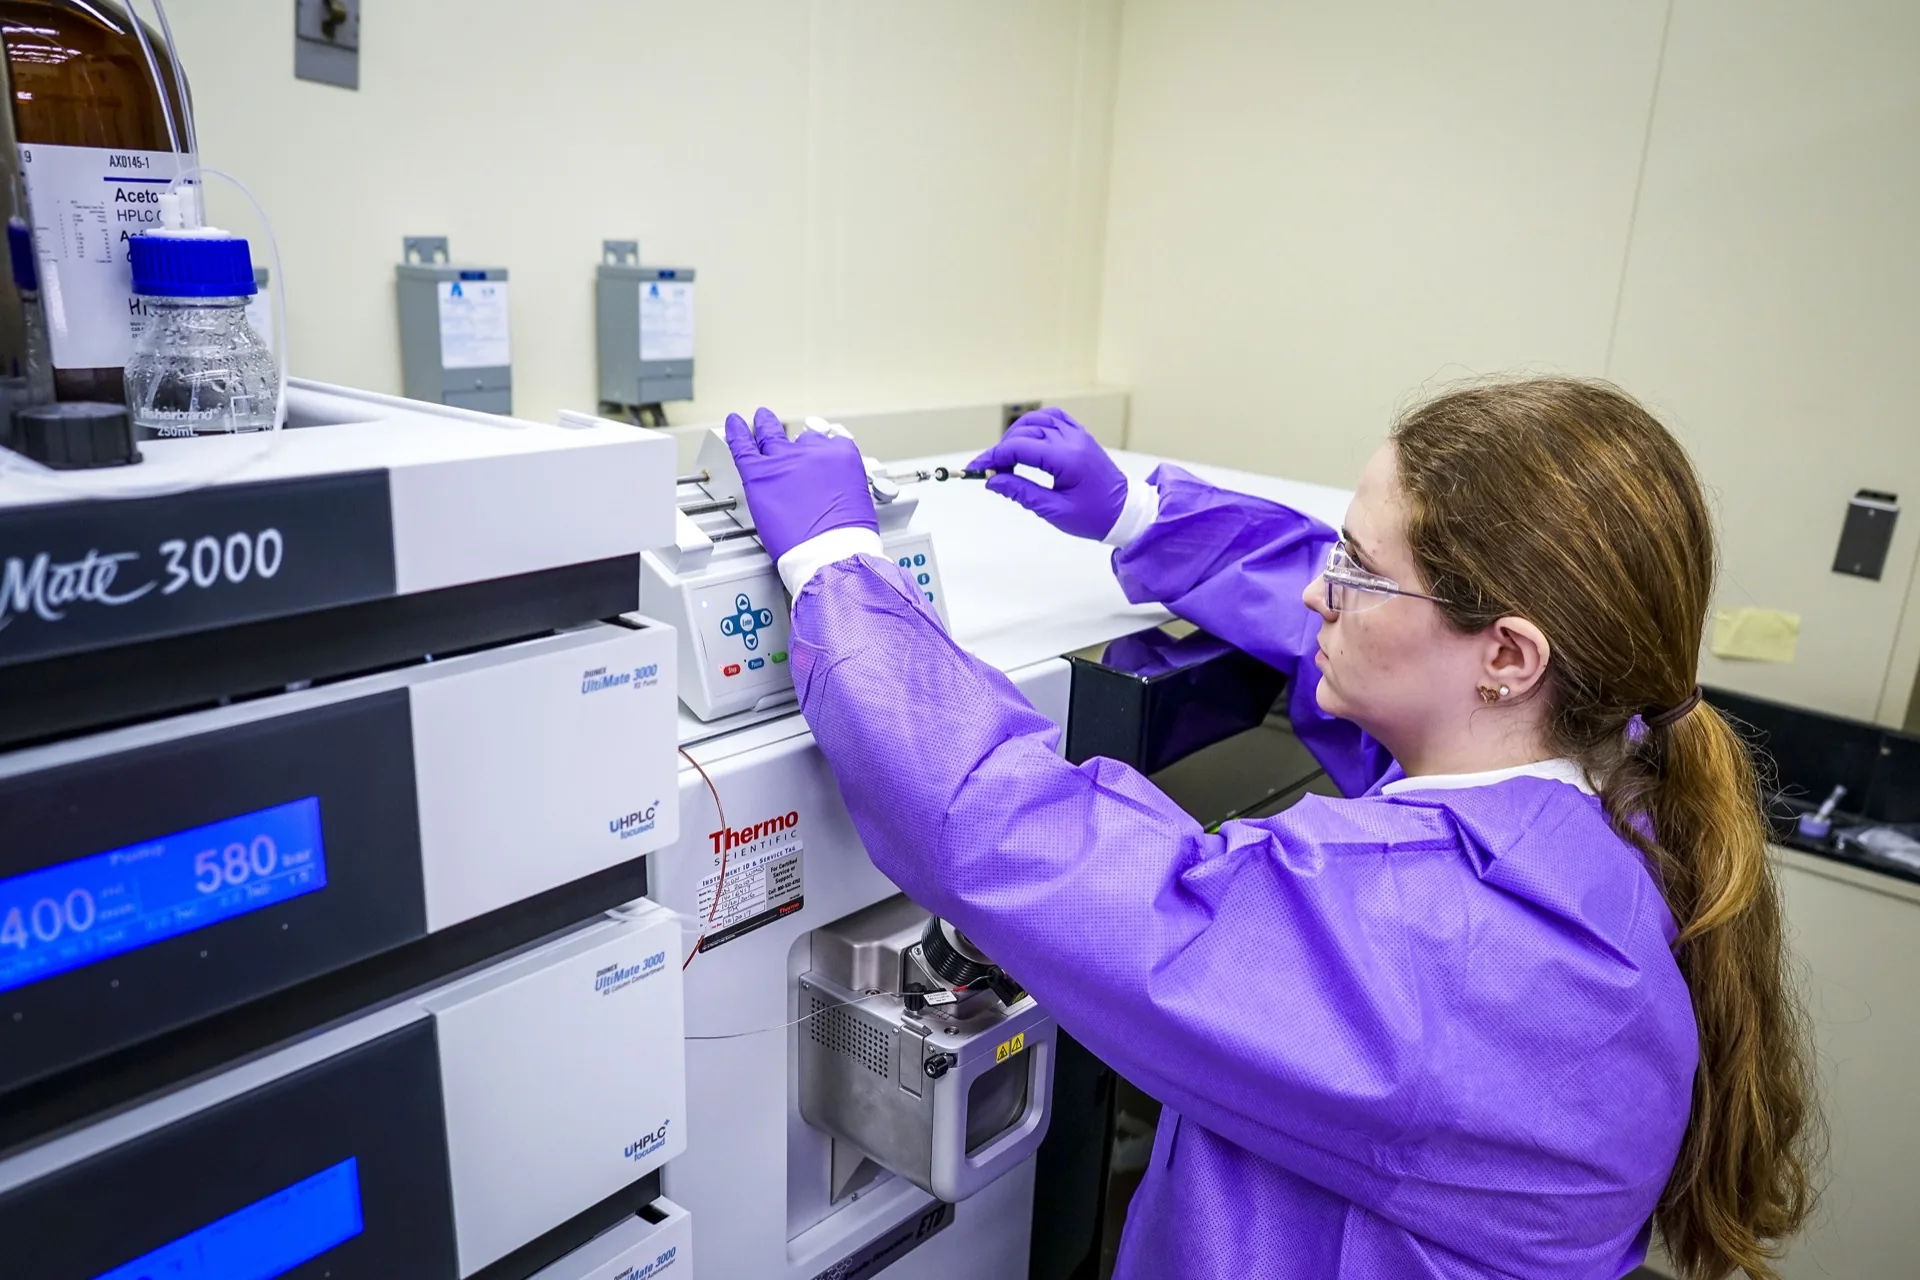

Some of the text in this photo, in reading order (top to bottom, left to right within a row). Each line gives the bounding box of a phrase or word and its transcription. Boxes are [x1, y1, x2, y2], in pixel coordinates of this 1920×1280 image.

[109, 154, 150, 168] AX0145-1
[115, 187, 160, 204] Aceto
[116, 209, 154, 222] HPLC
[160, 528, 283, 594] 3000
[582, 663, 658, 694] UltiMate 3000
[620, 819, 655, 840] focused
[709, 811, 799, 854] Thermo
[195, 834, 277, 894] 580
[703, 867, 741, 887] INSTRMENT
[0, 889, 95, 949] 400
[595, 951, 665, 991] UltiMate 3000
[634, 1138, 666, 1162] focused
[655, 1246, 677, 1268] 3000
